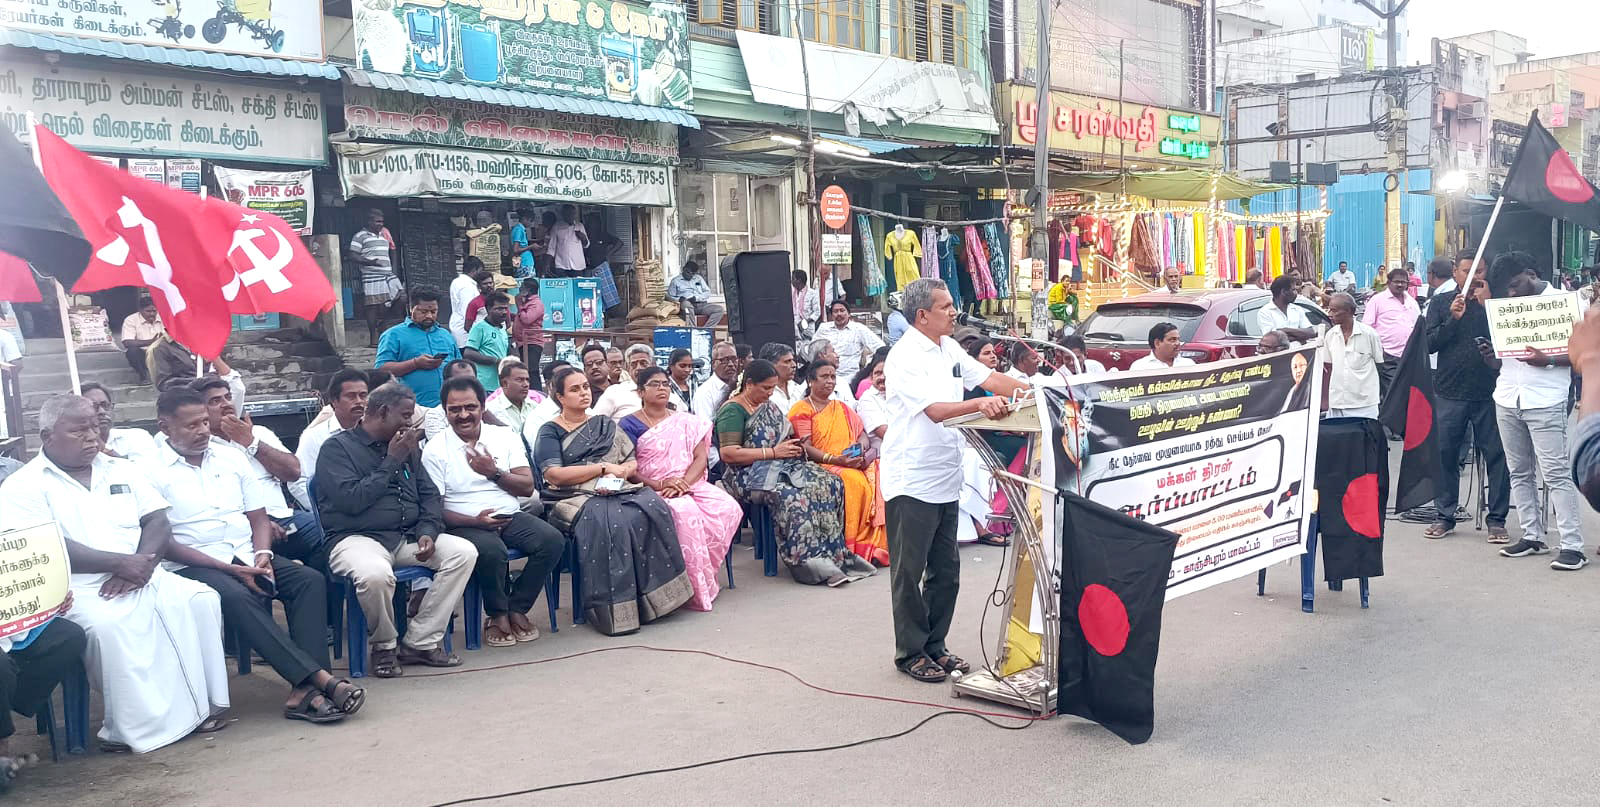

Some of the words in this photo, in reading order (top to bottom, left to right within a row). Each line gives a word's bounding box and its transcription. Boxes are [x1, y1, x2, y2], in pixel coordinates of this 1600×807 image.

[73, 15, 147, 37] கிடைக்கும்.
[120, 82, 183, 107] அம்மன்
[242, 93, 277, 122] சக்தி
[93, 113, 172, 143] விதைகள்
[180, 119, 263, 150] கிடைக்கும்.
[345, 105, 448, 136] நெல்
[464, 116, 627, 151] விதைகள்
[1056, 102, 1158, 152] சரஸ்வதி
[247, 185, 280, 198] MPR
[284, 184, 305, 197] 606
[470, 178, 527, 194] விதைகள்
[533, 182, 592, 199] கிடைக்கும்
[555, 164, 587, 182] 606,
[639, 169, 665, 186] TPS-5
[1157, 467, 1197, 489] மக்கள்
[1202, 458, 1233, 482] திரள்
[1183, 547, 1227, 574] காஞ்சிபுரம்
[1227, 537, 1261, 559] மாவட்டம்
